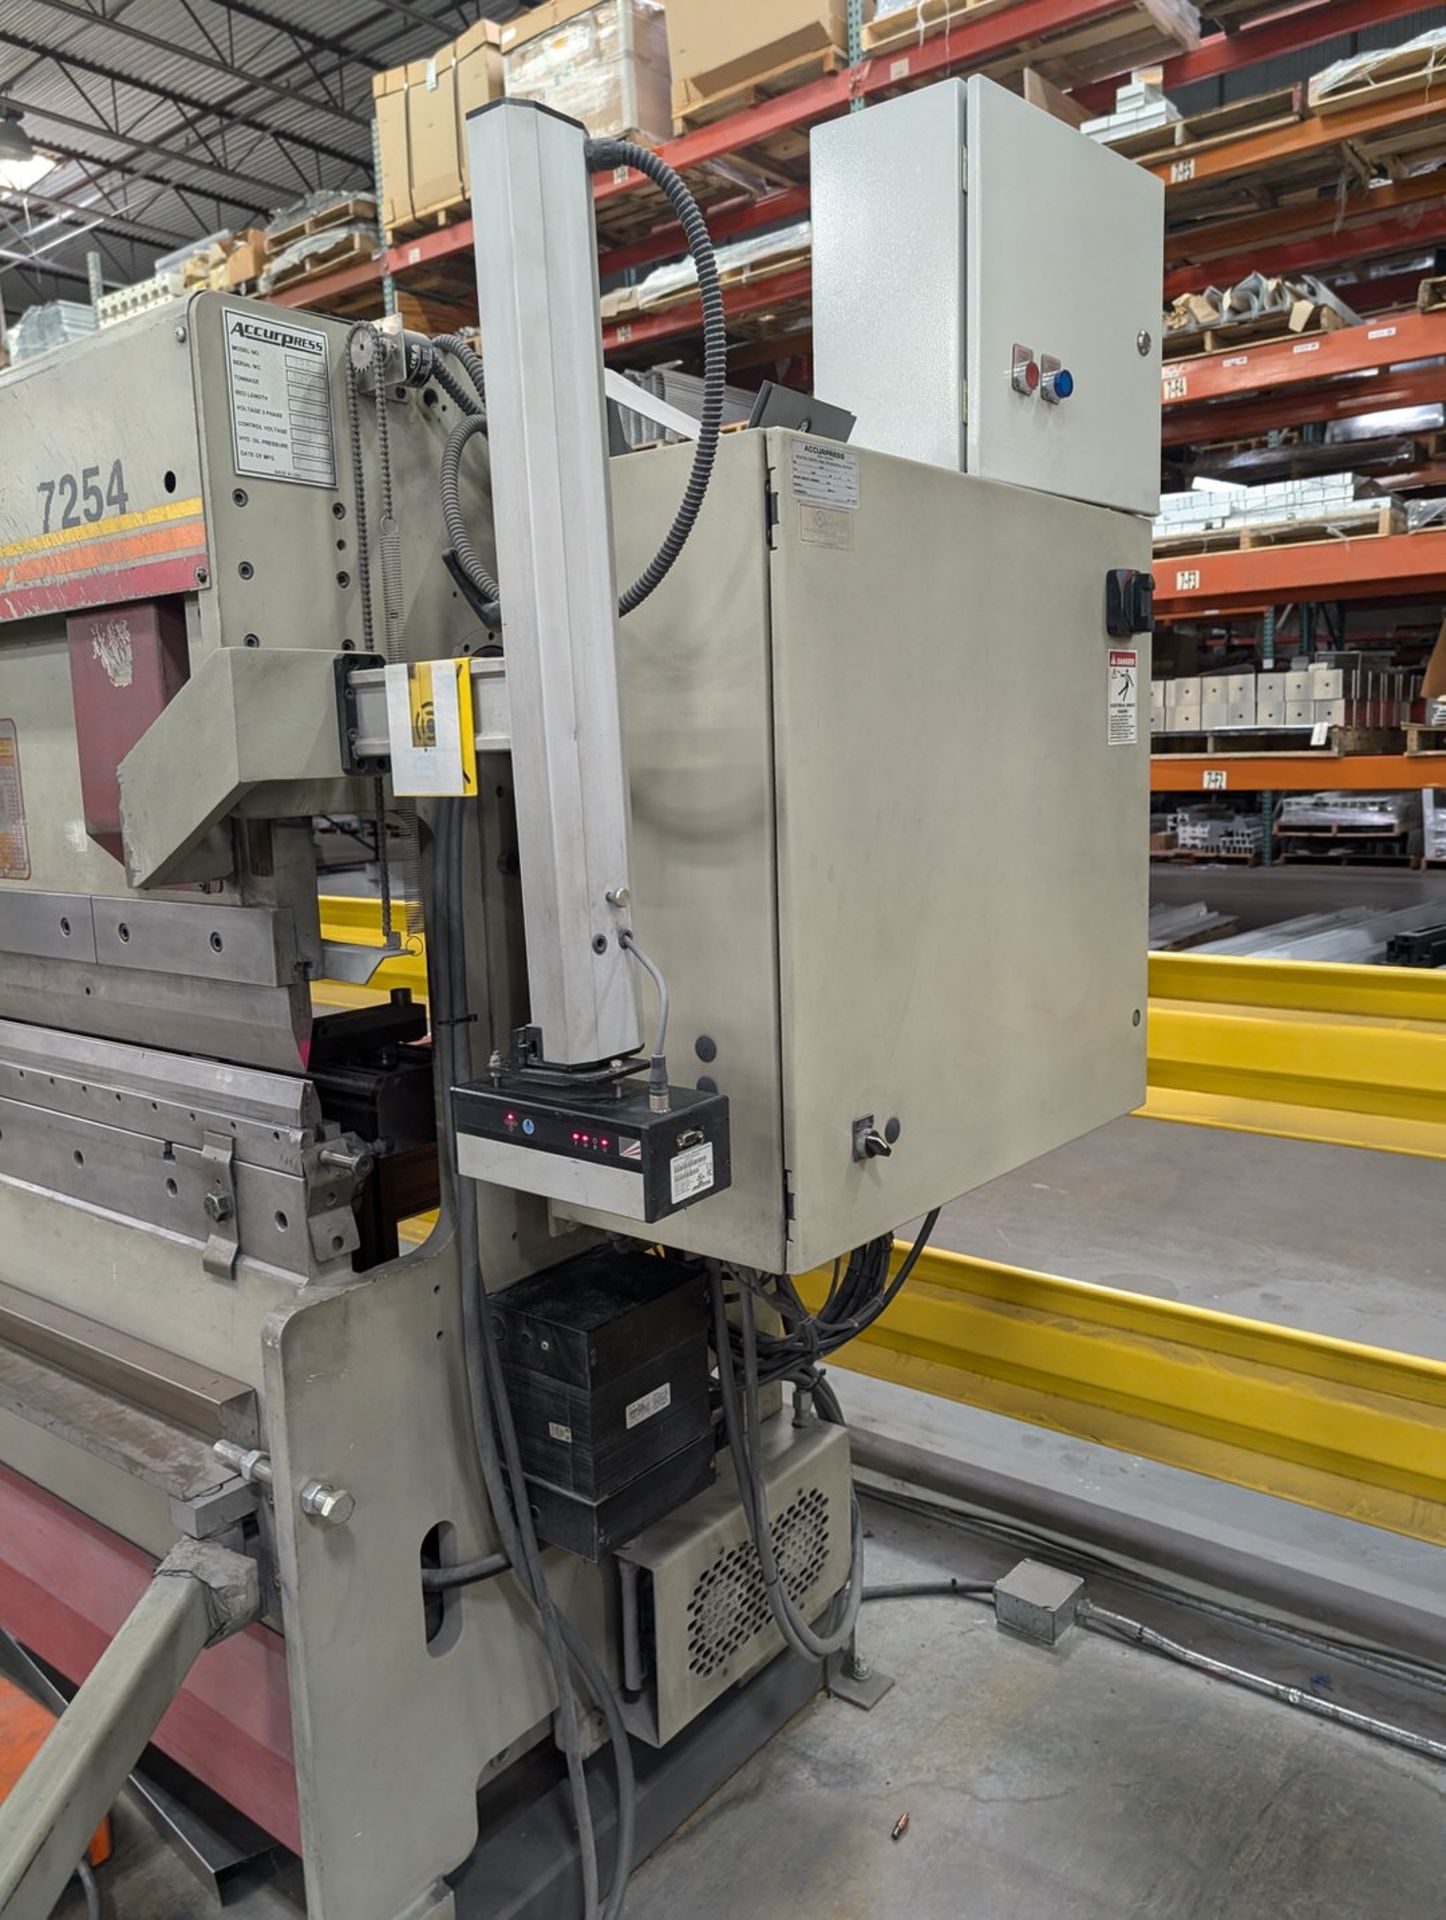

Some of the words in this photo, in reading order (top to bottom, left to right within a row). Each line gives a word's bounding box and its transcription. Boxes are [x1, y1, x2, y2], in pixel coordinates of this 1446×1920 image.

[233, 359, 251, 368] SERIAL
[234, 374, 259, 384] TONNAGE
[247, 391, 268, 400] LENGTH
[237, 405, 261, 414] VOLTAGE
[266, 410, 283, 418] PHASE
[238, 420, 262, 430] CONTROL
[263, 425, 288, 434] VOLTAGE
[261, 439, 288, 449] PRESSURE
[36, 458, 128, 534] 7254
